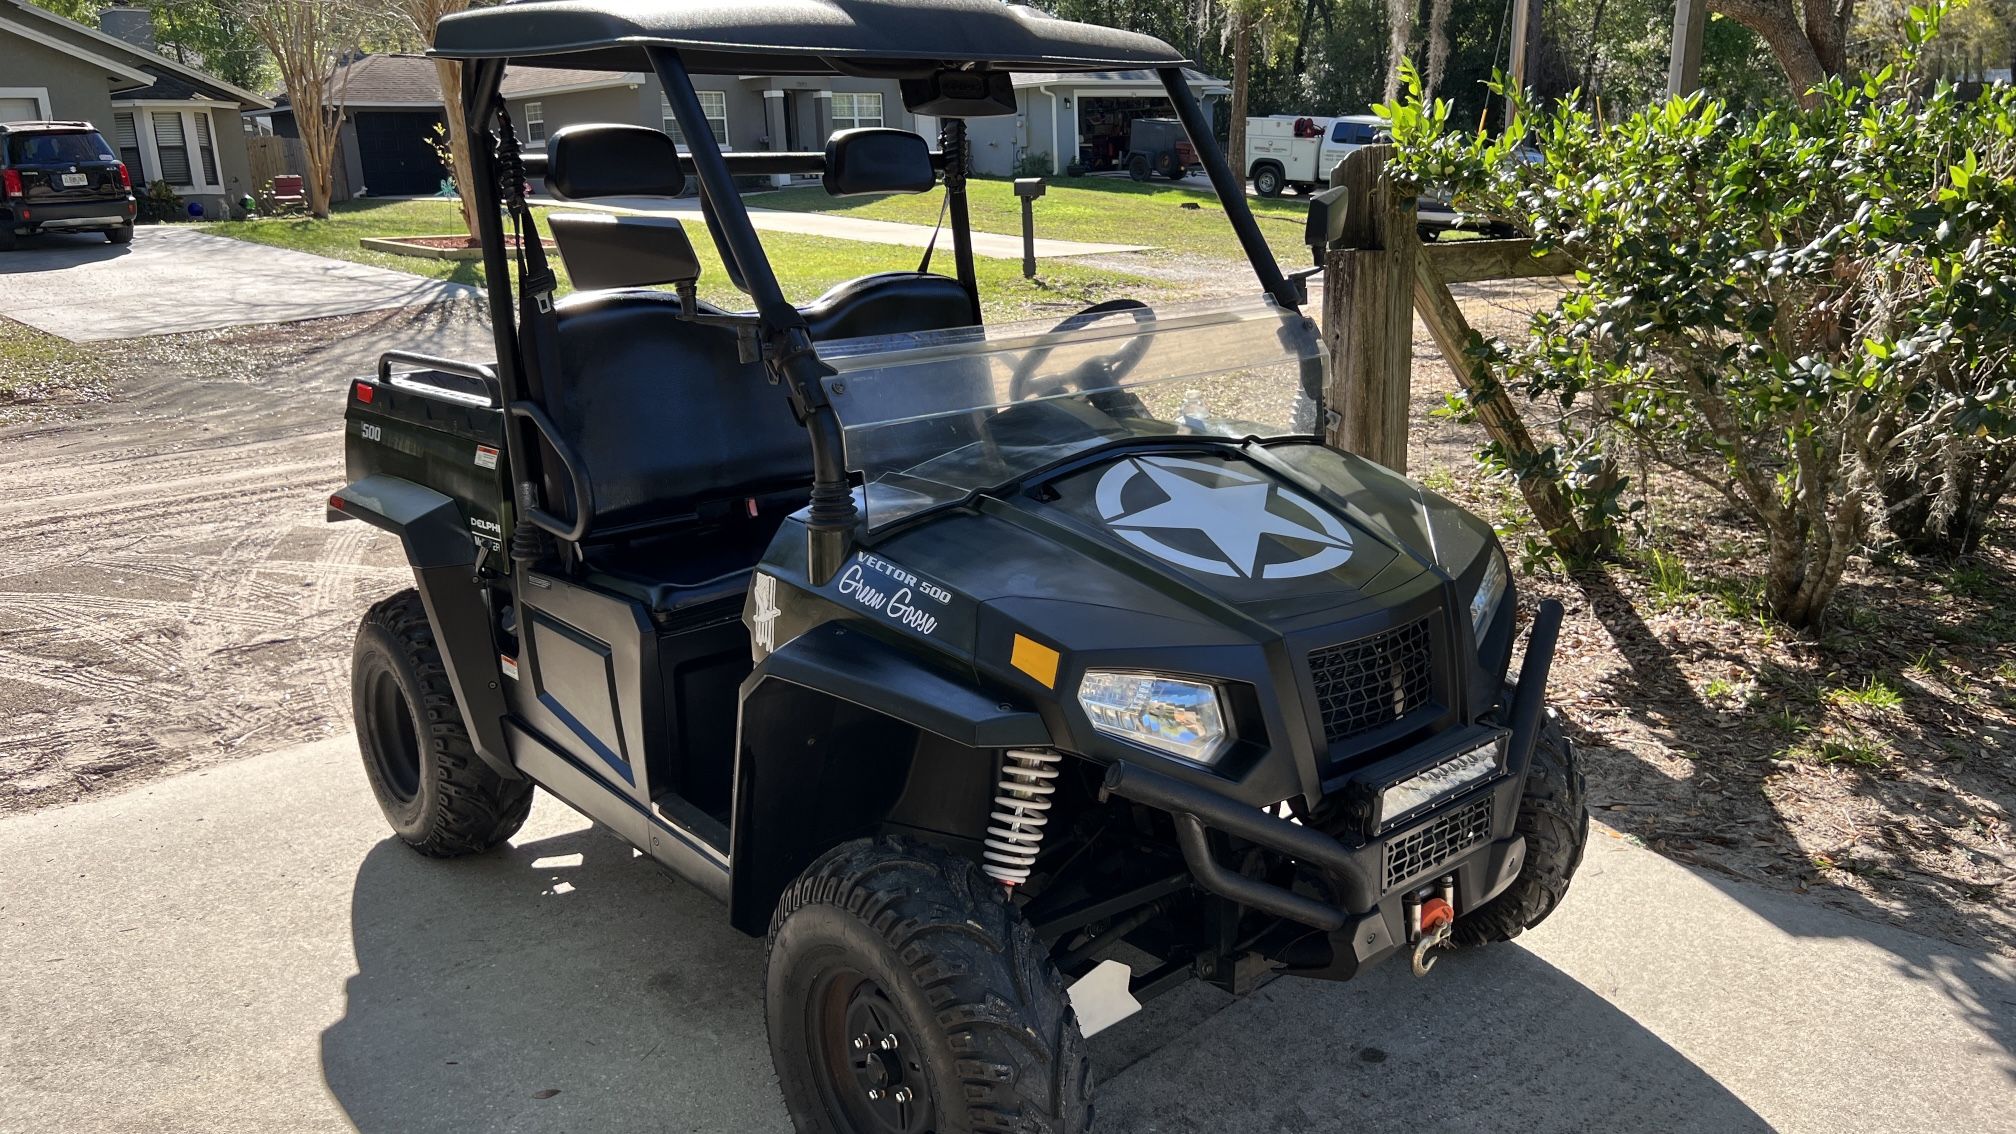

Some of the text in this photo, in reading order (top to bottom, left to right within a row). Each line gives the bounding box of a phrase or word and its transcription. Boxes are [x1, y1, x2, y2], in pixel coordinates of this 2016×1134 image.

[362, 423, 382, 442] 500
[470, 517, 501, 533] DELPHI
[858, 550, 952, 604] VECTOR 500
[838, 564, 938, 635] Green Goose
